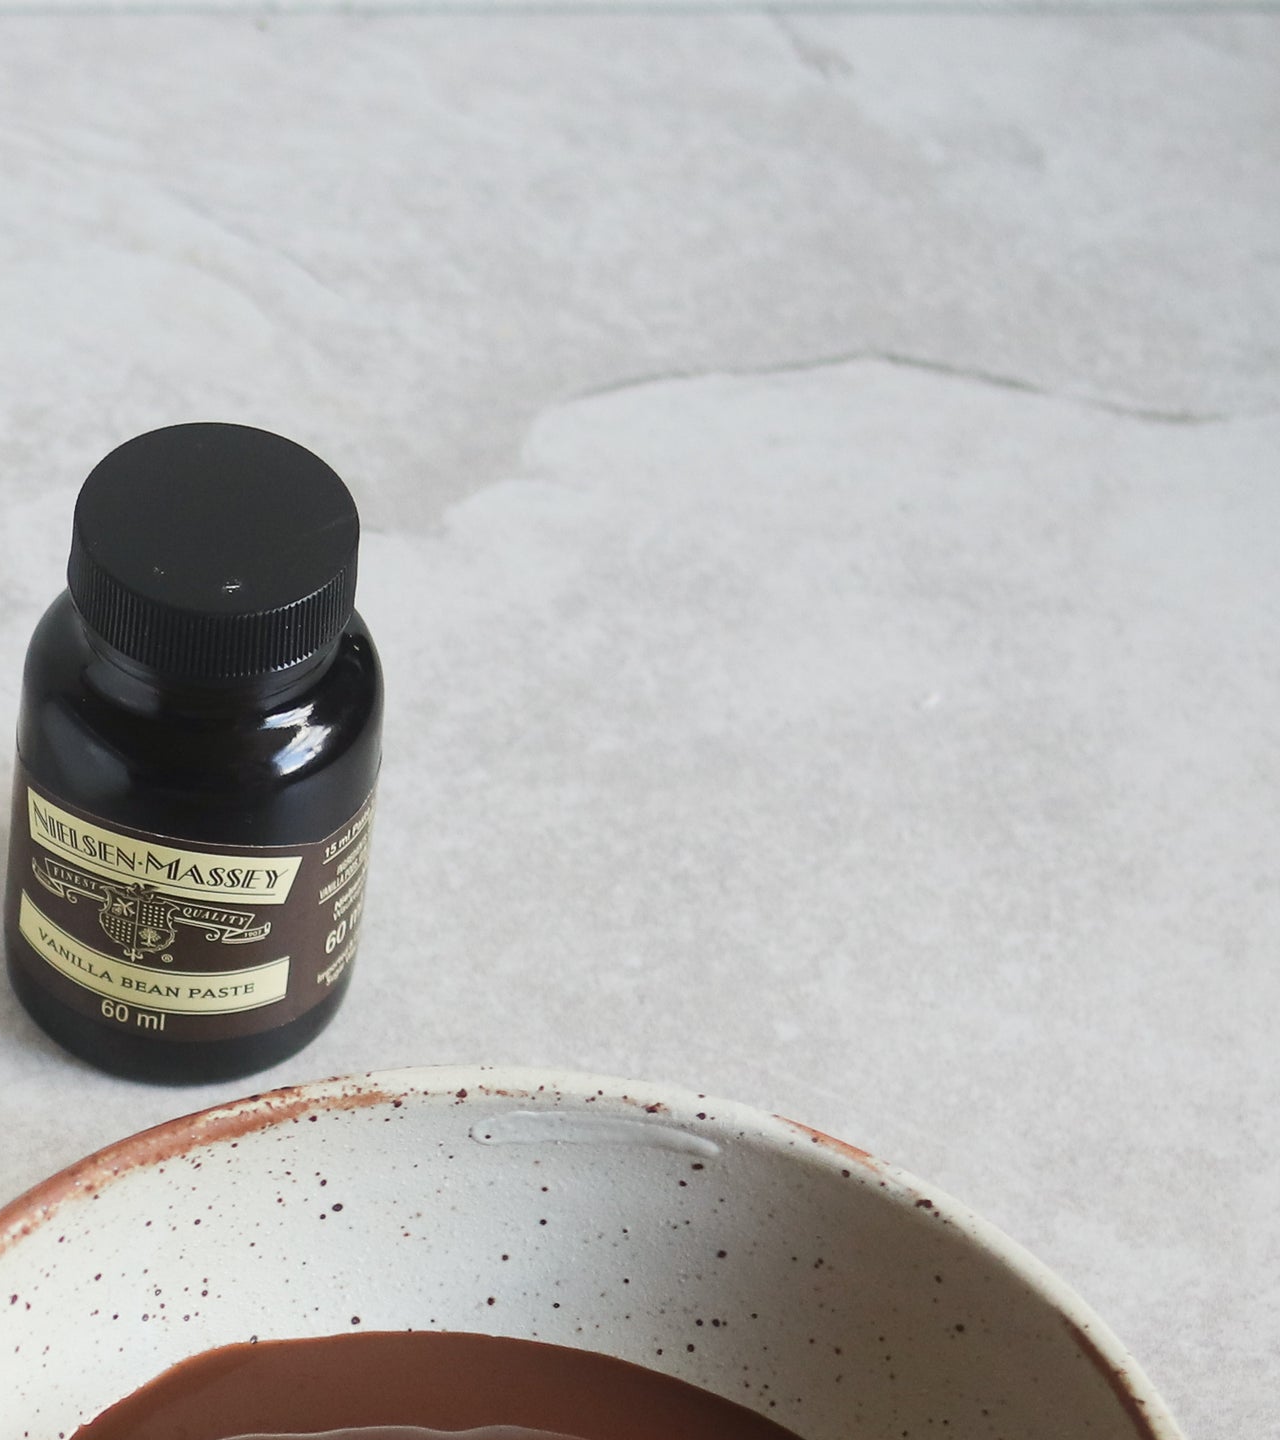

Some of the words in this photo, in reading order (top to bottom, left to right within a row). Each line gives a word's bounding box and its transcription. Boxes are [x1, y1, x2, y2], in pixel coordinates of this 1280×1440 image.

[325, 841, 337, 858] 15
[53, 866, 97, 890] FINEST
[182, 906, 249, 926] QUALITY
[325, 920, 347, 954] 60
[38, 926, 114, 983] VANILLA
[120, 976, 180, 998] BEAN
[188, 982, 255, 1000] PASTE
[100, 999, 130, 1023] 60
[136, 1010, 166, 1031] ml
